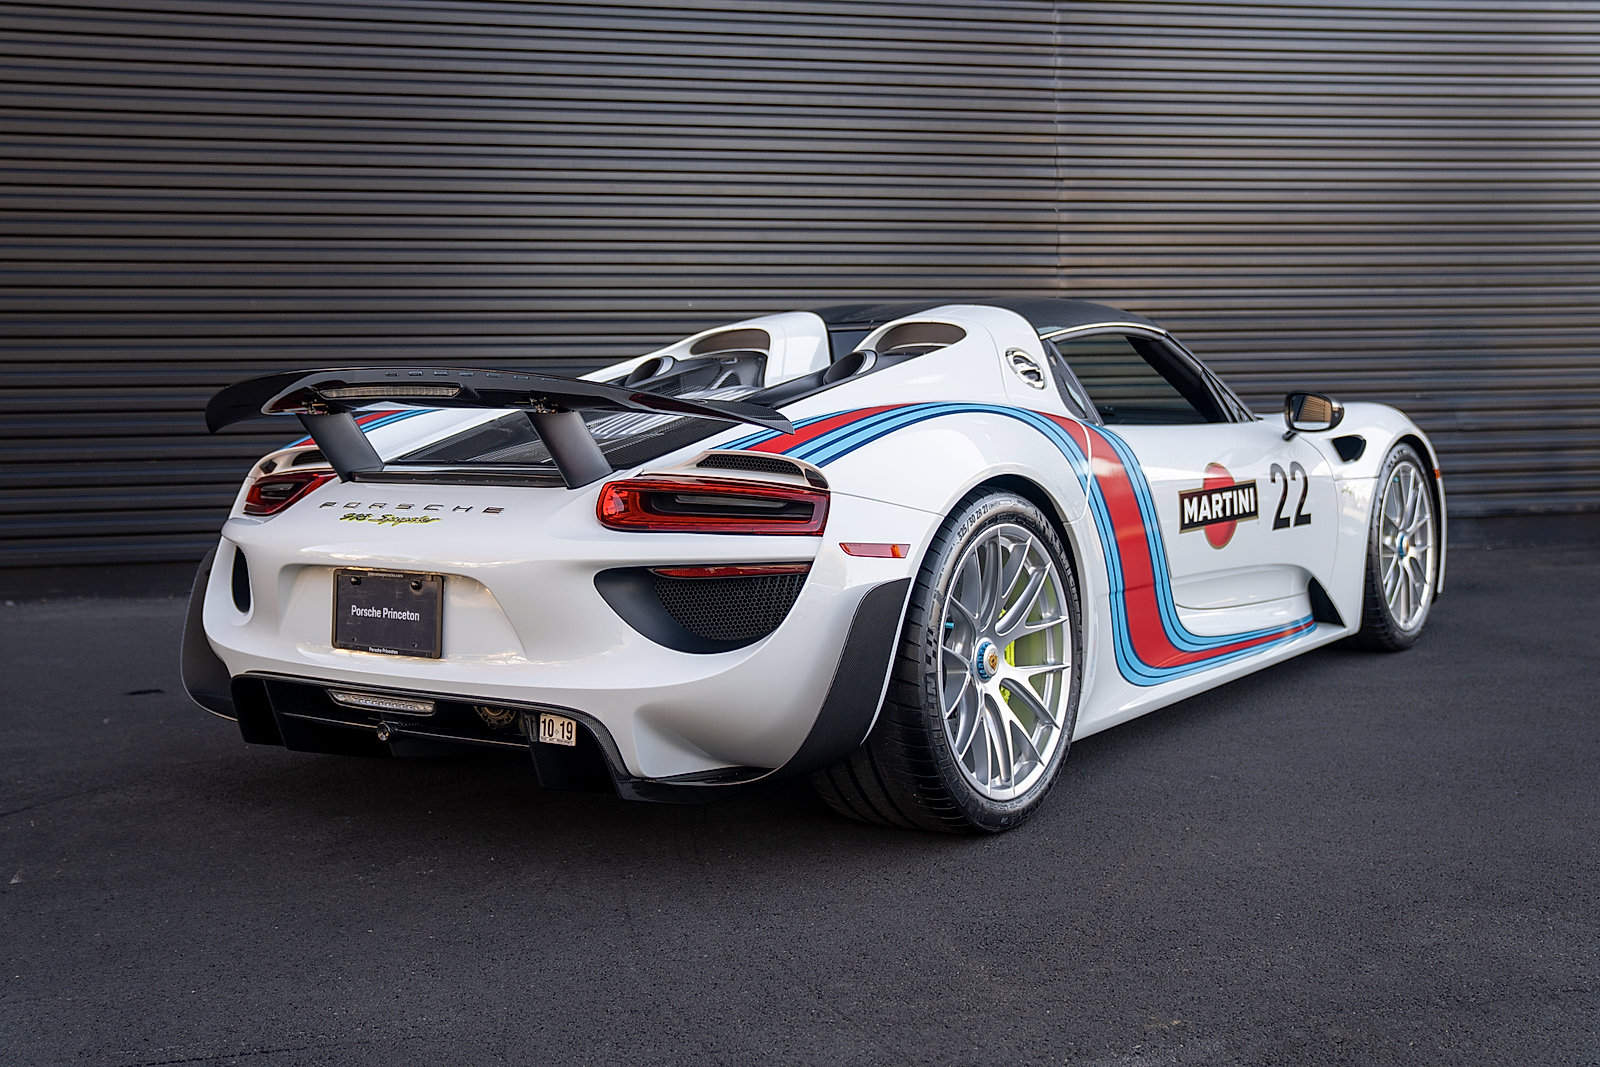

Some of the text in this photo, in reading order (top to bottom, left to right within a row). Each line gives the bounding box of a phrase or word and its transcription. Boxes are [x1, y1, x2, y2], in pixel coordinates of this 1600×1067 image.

[1183, 487, 1256, 524] MARTINI
[1270, 461, 1312, 531] 22
[318, 501, 505, 514] PORSCHE
[368, 514, 442, 527] Spyder
[351, 604, 420, 621] Porsche Princeton
[541, 718, 573, 740] 10 19
